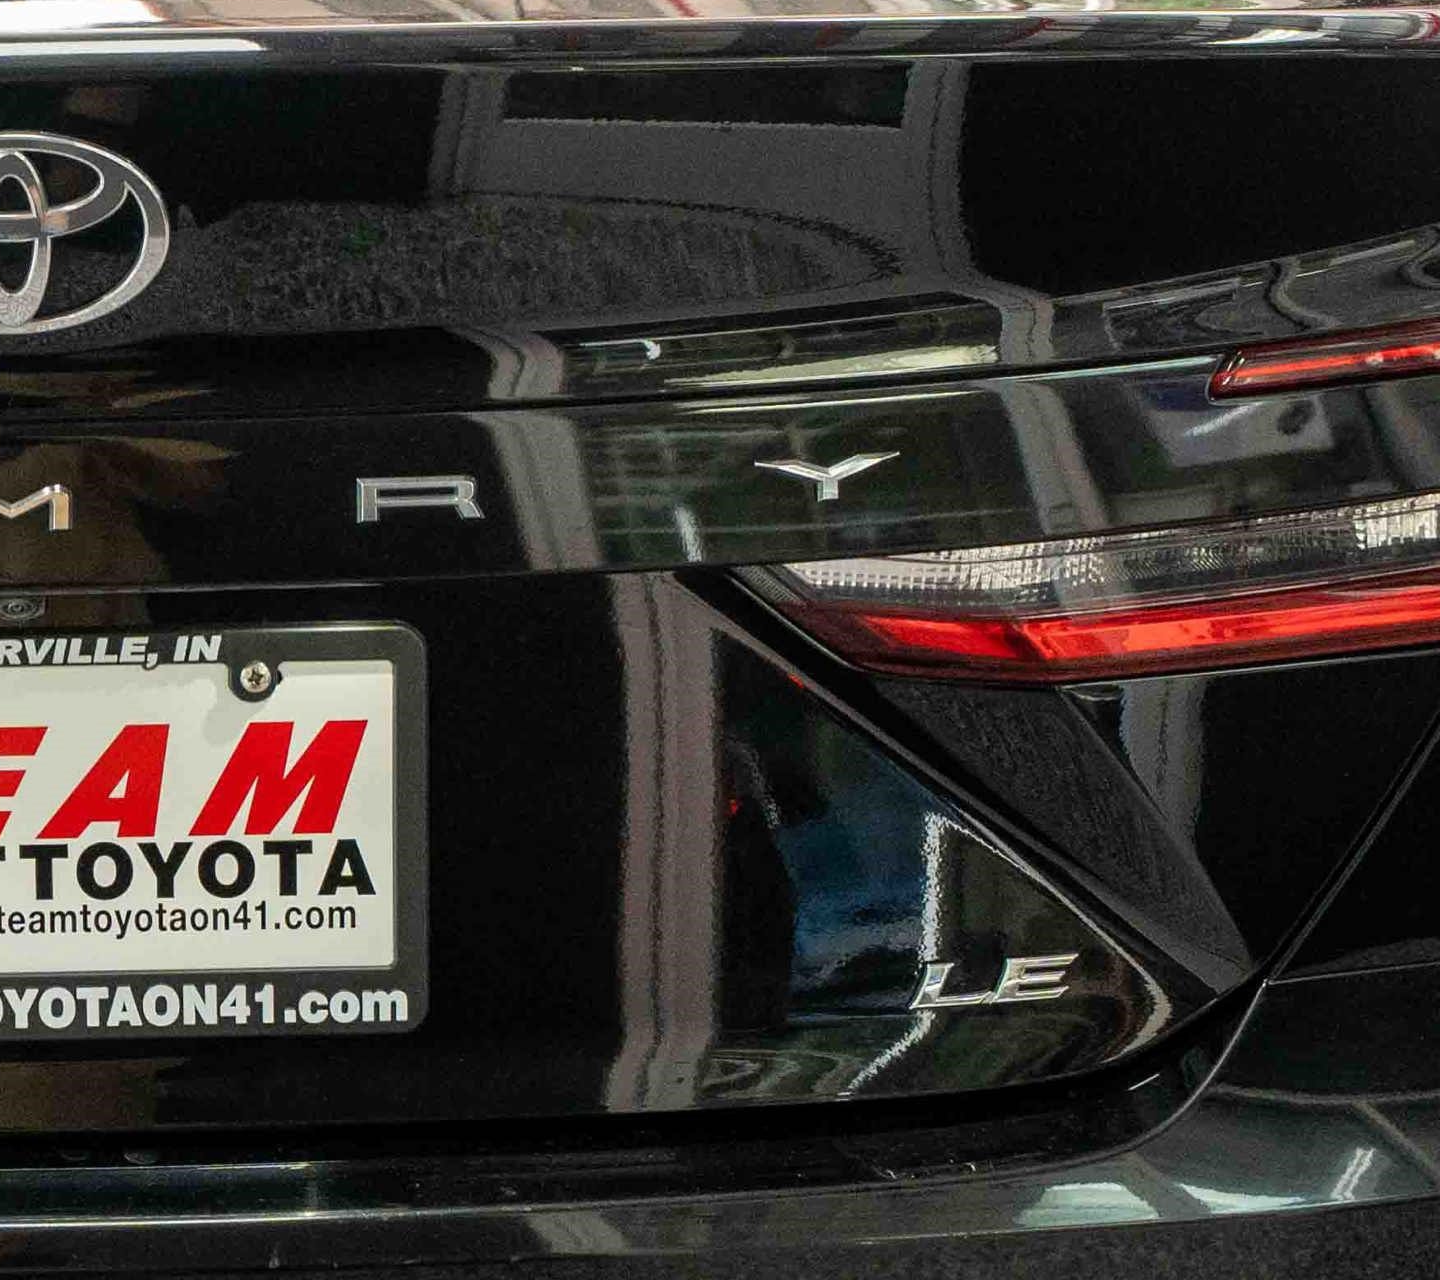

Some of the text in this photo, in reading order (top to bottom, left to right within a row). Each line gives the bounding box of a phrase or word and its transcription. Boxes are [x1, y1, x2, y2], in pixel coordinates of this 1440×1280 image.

[173, 635, 222, 663] IN
[18, 839, 375, 901] TOYOTA
[909, 953, 1080, 1009] LE
